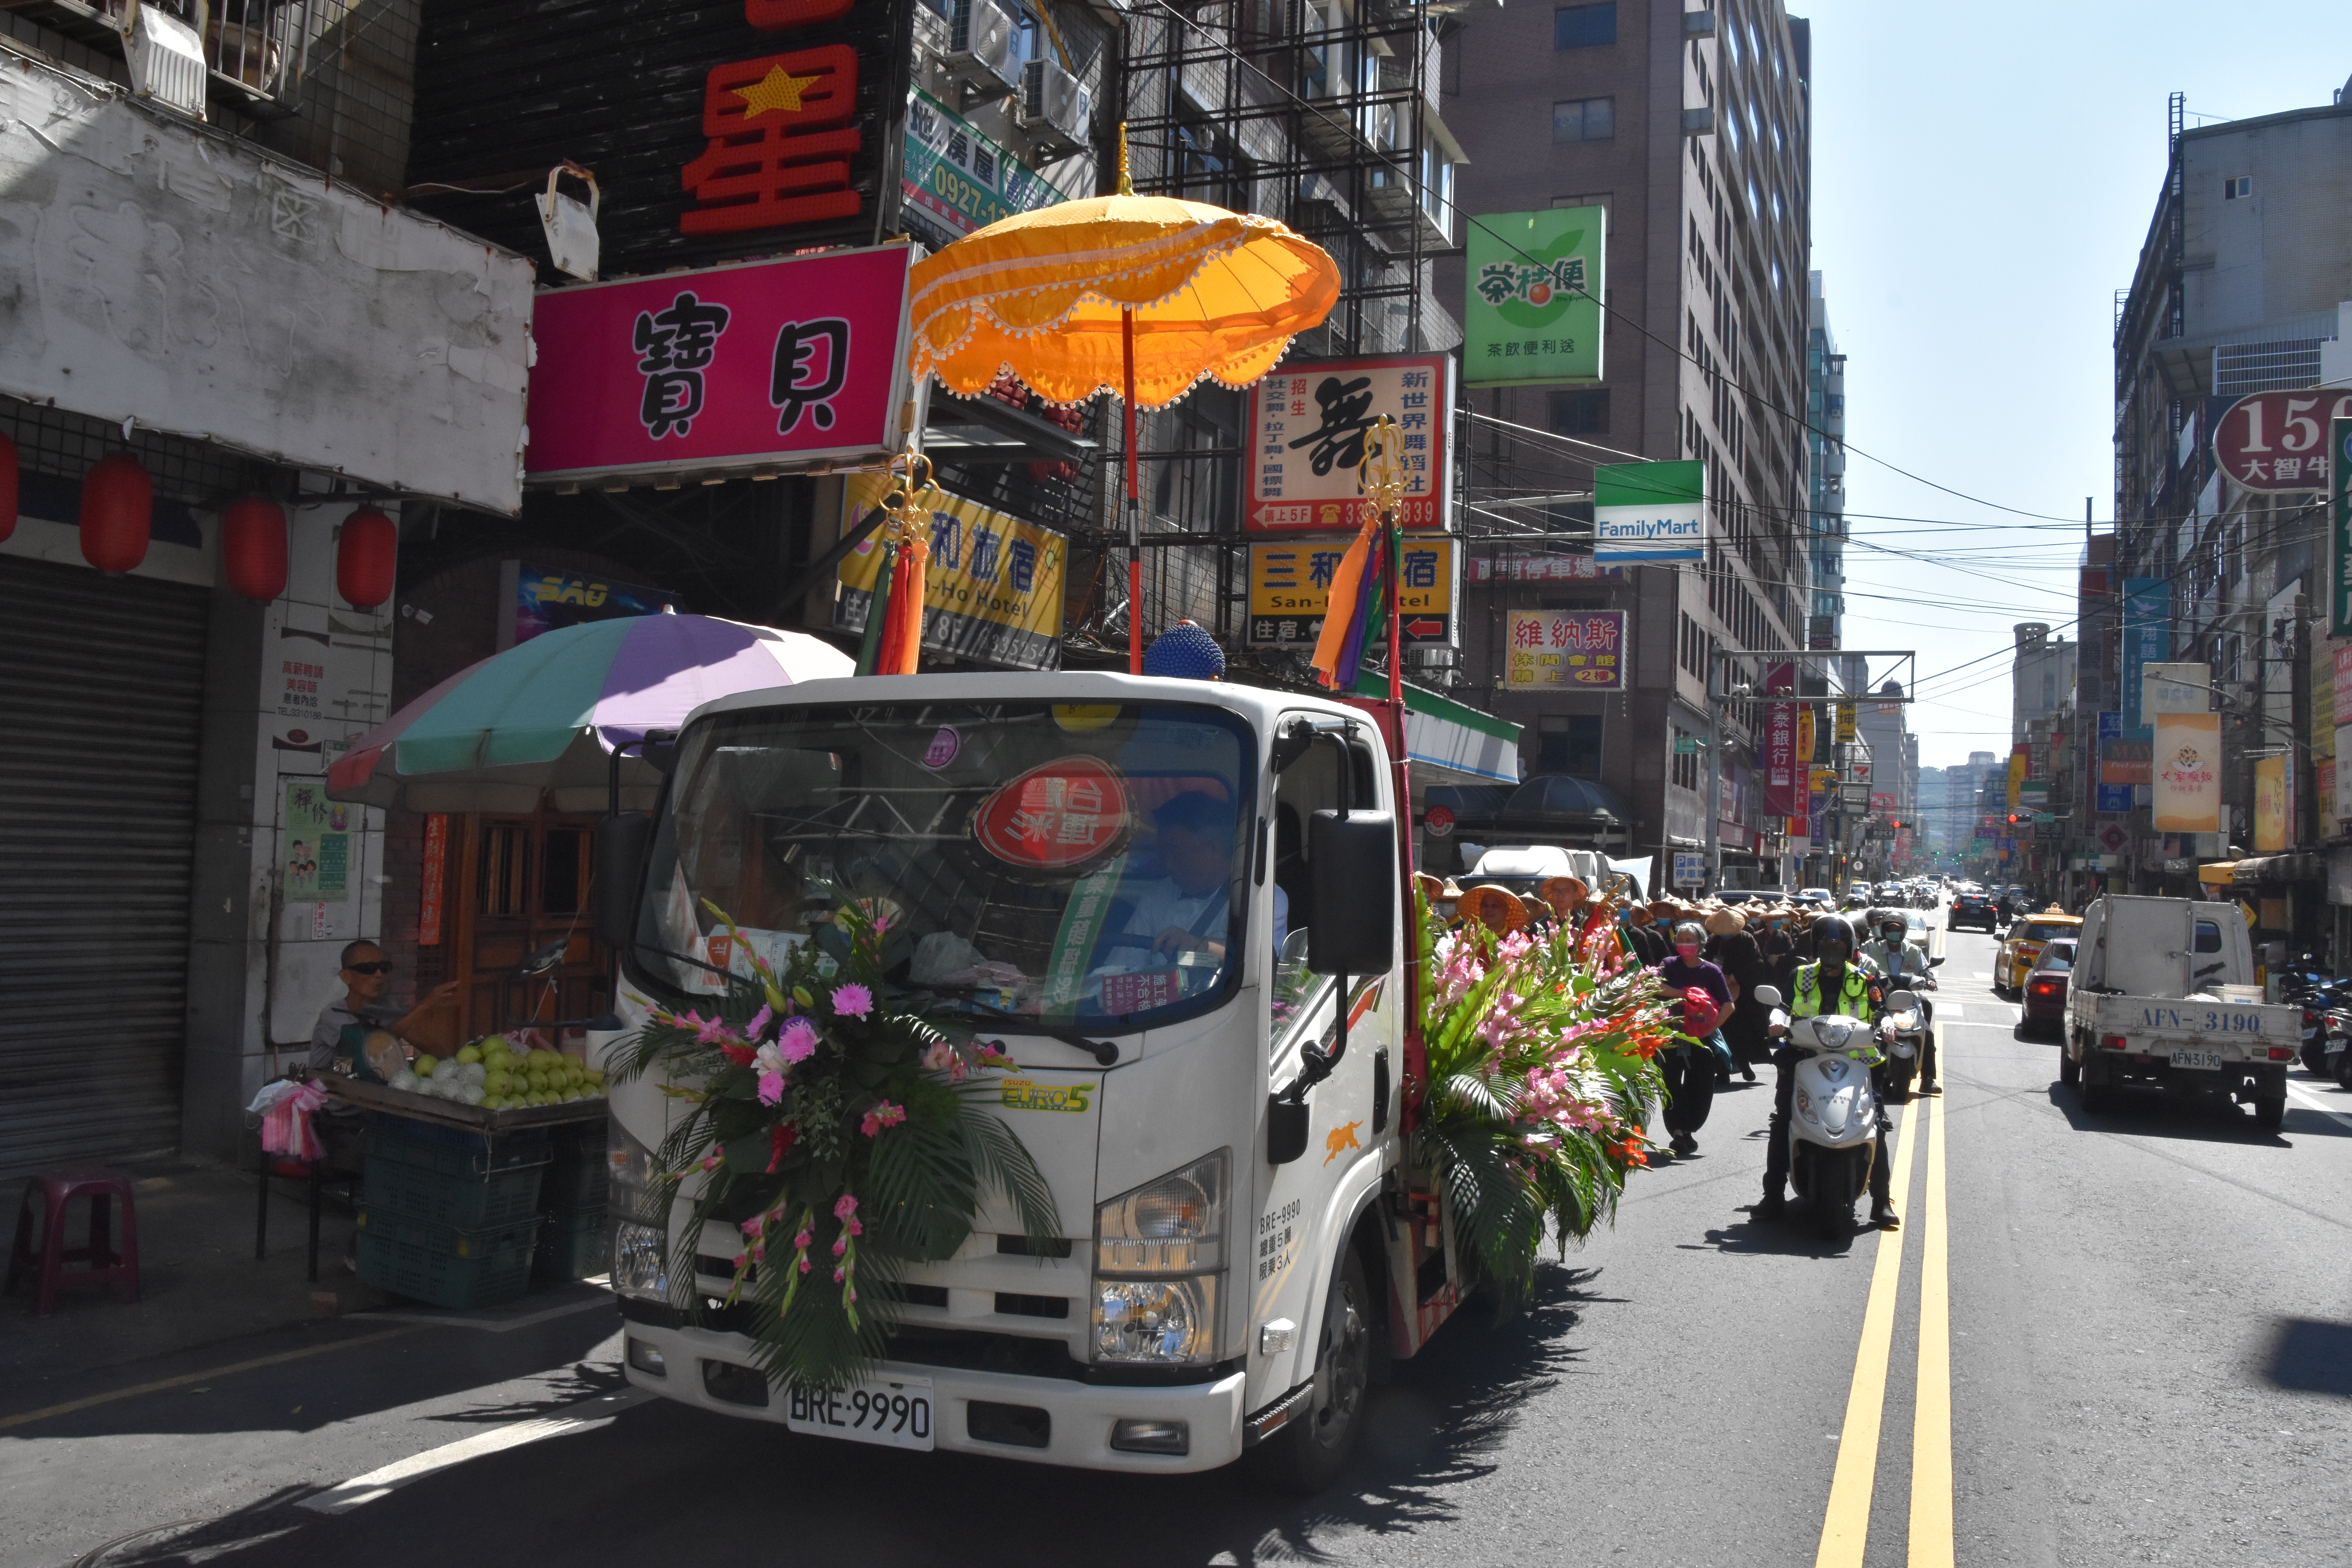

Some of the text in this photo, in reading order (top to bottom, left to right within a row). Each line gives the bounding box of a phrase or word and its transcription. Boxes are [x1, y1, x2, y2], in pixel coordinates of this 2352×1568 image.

[1487, 338, 1575, 358] 茶飲便利送
[632, 290, 851, 440] 寶貝
[1290, 378, 1307, 416] 招生
[1400, 371, 1429, 493] 新世界舞蹈社
[1599, 519, 1699, 539] FamilyMart
[1263, 550, 1439, 590] 三和宿
[976, 588, 1027, 618] Hotel
[1513, 618, 1617, 649] 維納斯
[286, 677, 317, 693] 美容師
[1137, 975, 1151, 1011] 不合格
[1153, 974, 1167, 1007] 施工架
[2205, 1011, 2259, 1033] 3190
[2170, 1050, 2221, 1068] AFN-3190
[1259, 1198, 1301, 1235] BRE-9990
